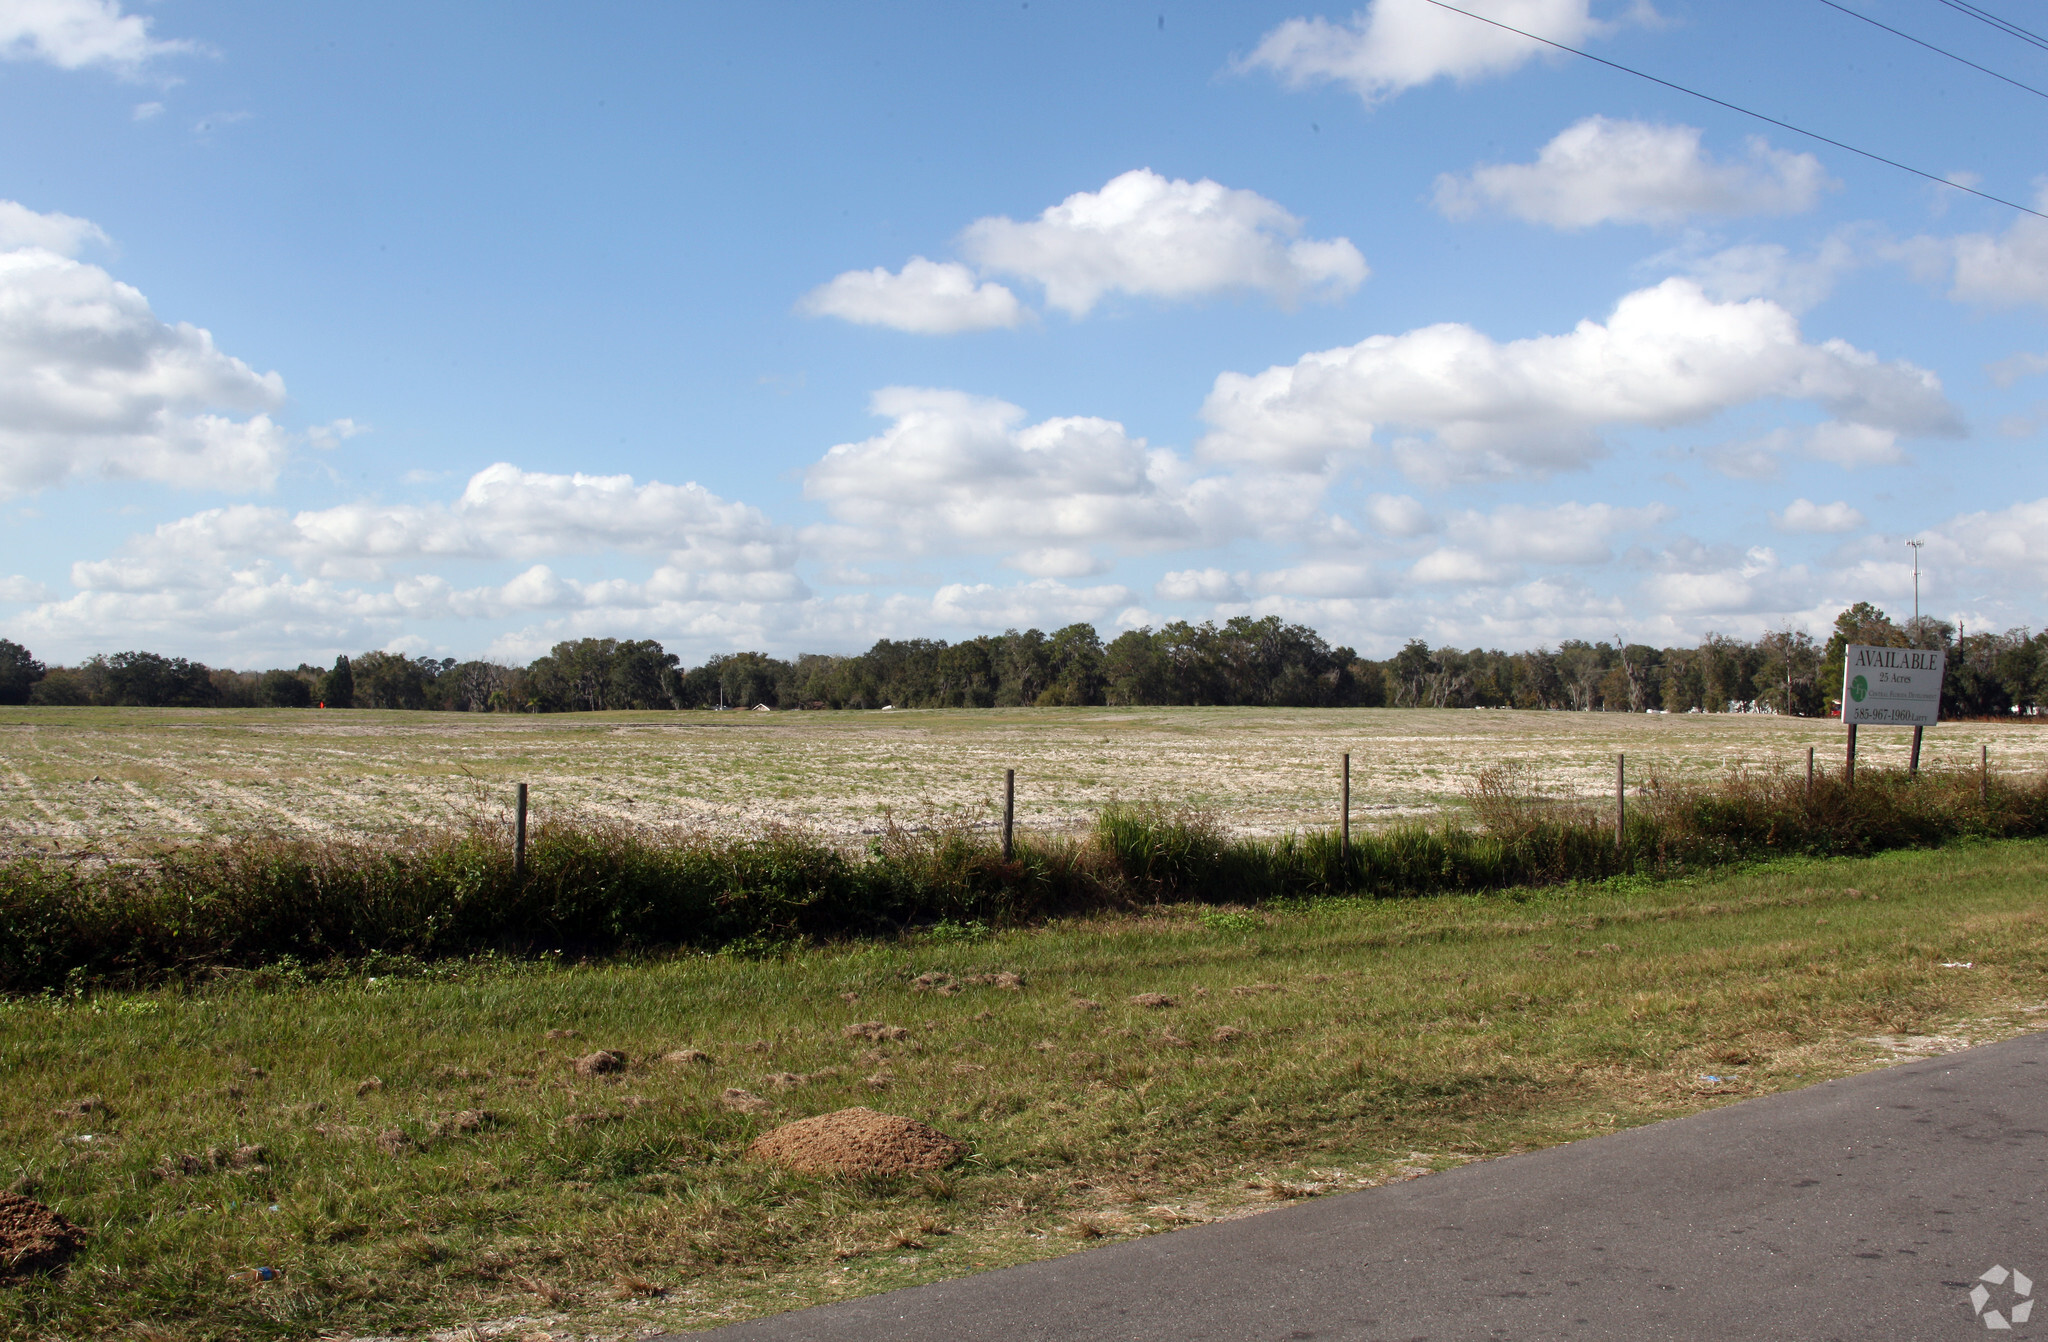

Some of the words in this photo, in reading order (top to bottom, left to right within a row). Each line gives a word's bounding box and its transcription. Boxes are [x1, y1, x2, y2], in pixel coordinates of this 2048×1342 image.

[1856, 650, 1937, 670] AVAILABLE
[1880, 672, 1889, 682] 25
[1891, 674, 1911, 683] Acres
